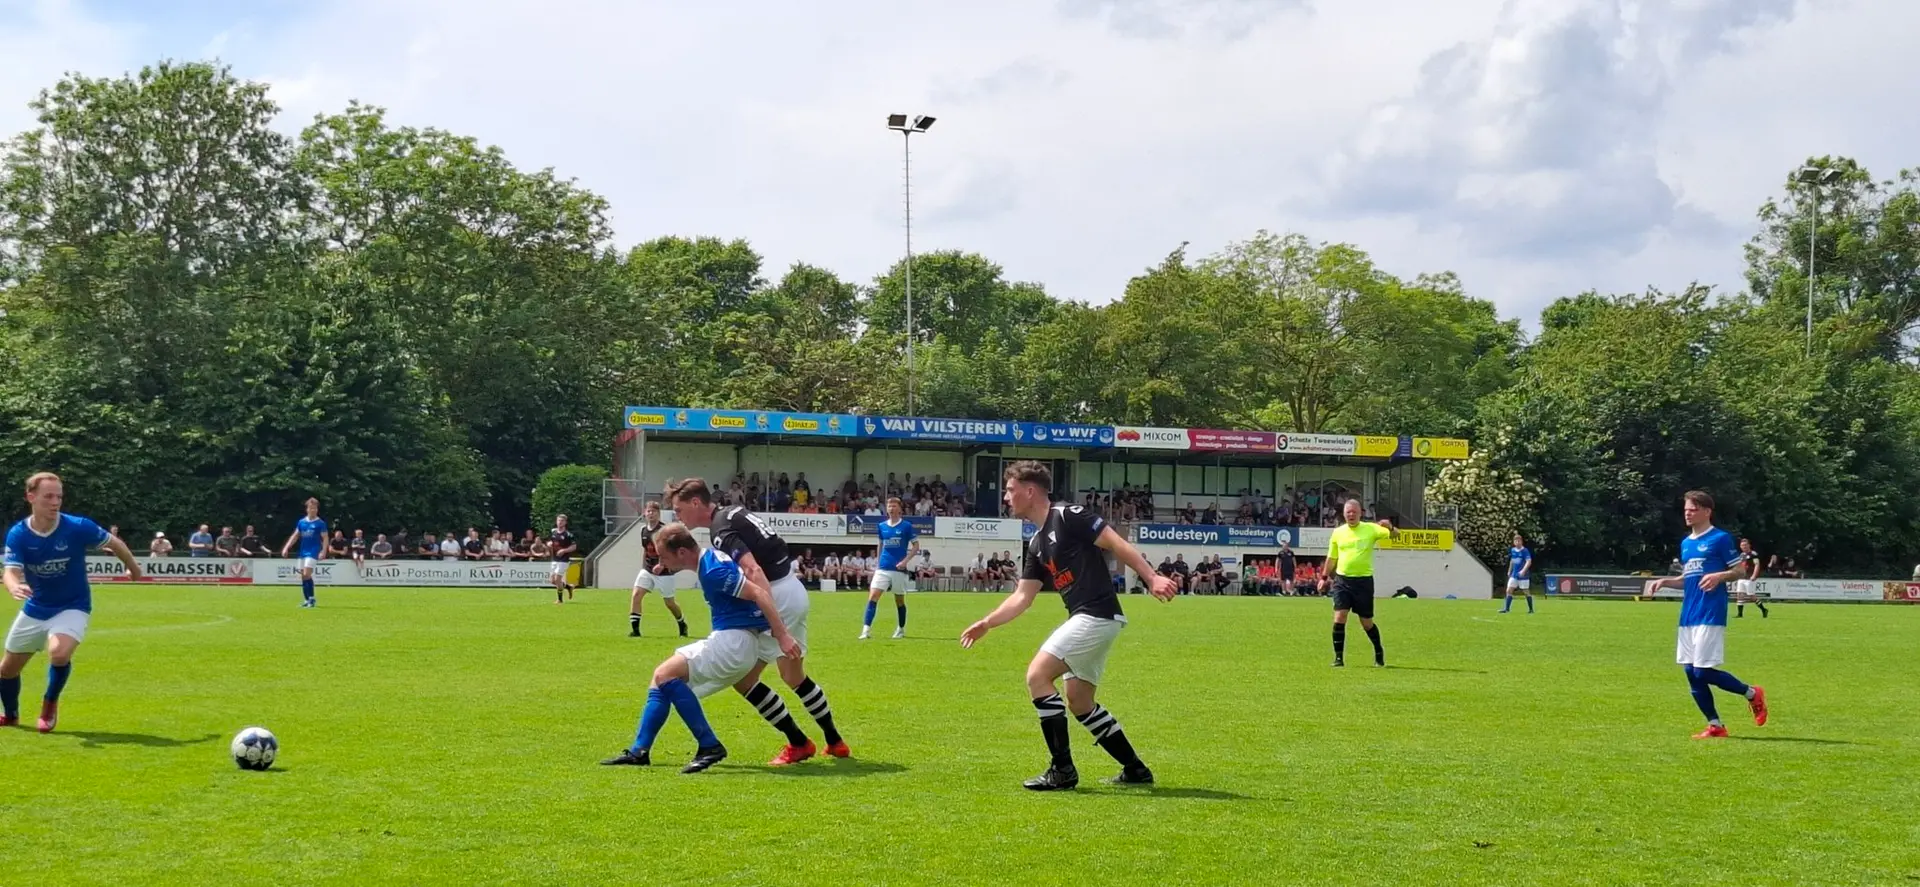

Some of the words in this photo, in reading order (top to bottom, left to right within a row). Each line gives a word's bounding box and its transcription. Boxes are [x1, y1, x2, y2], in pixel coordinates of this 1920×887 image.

[881, 418, 915, 432] VAN
[921, 420, 1007, 435] VILSTEREN
[1051, 429, 1066, 437] vv
[1069, 427, 1097, 438] WVF
[1143, 431, 1182, 442] MIXCOM
[768, 516, 829, 528] Hoveniers
[966, 523, 998, 531] KOLK
[1139, 526, 1218, 544] Boudesteyn
[1228, 527, 1274, 537] Boudesteyn
[85, 562, 141, 575] GARA
[146, 562, 225, 575] KLAASSEN
[292, 566, 331, 575] KLK
[469, 568, 550, 579] RAAD-Postma
[1842, 581, 1874, 591] Valentijn
